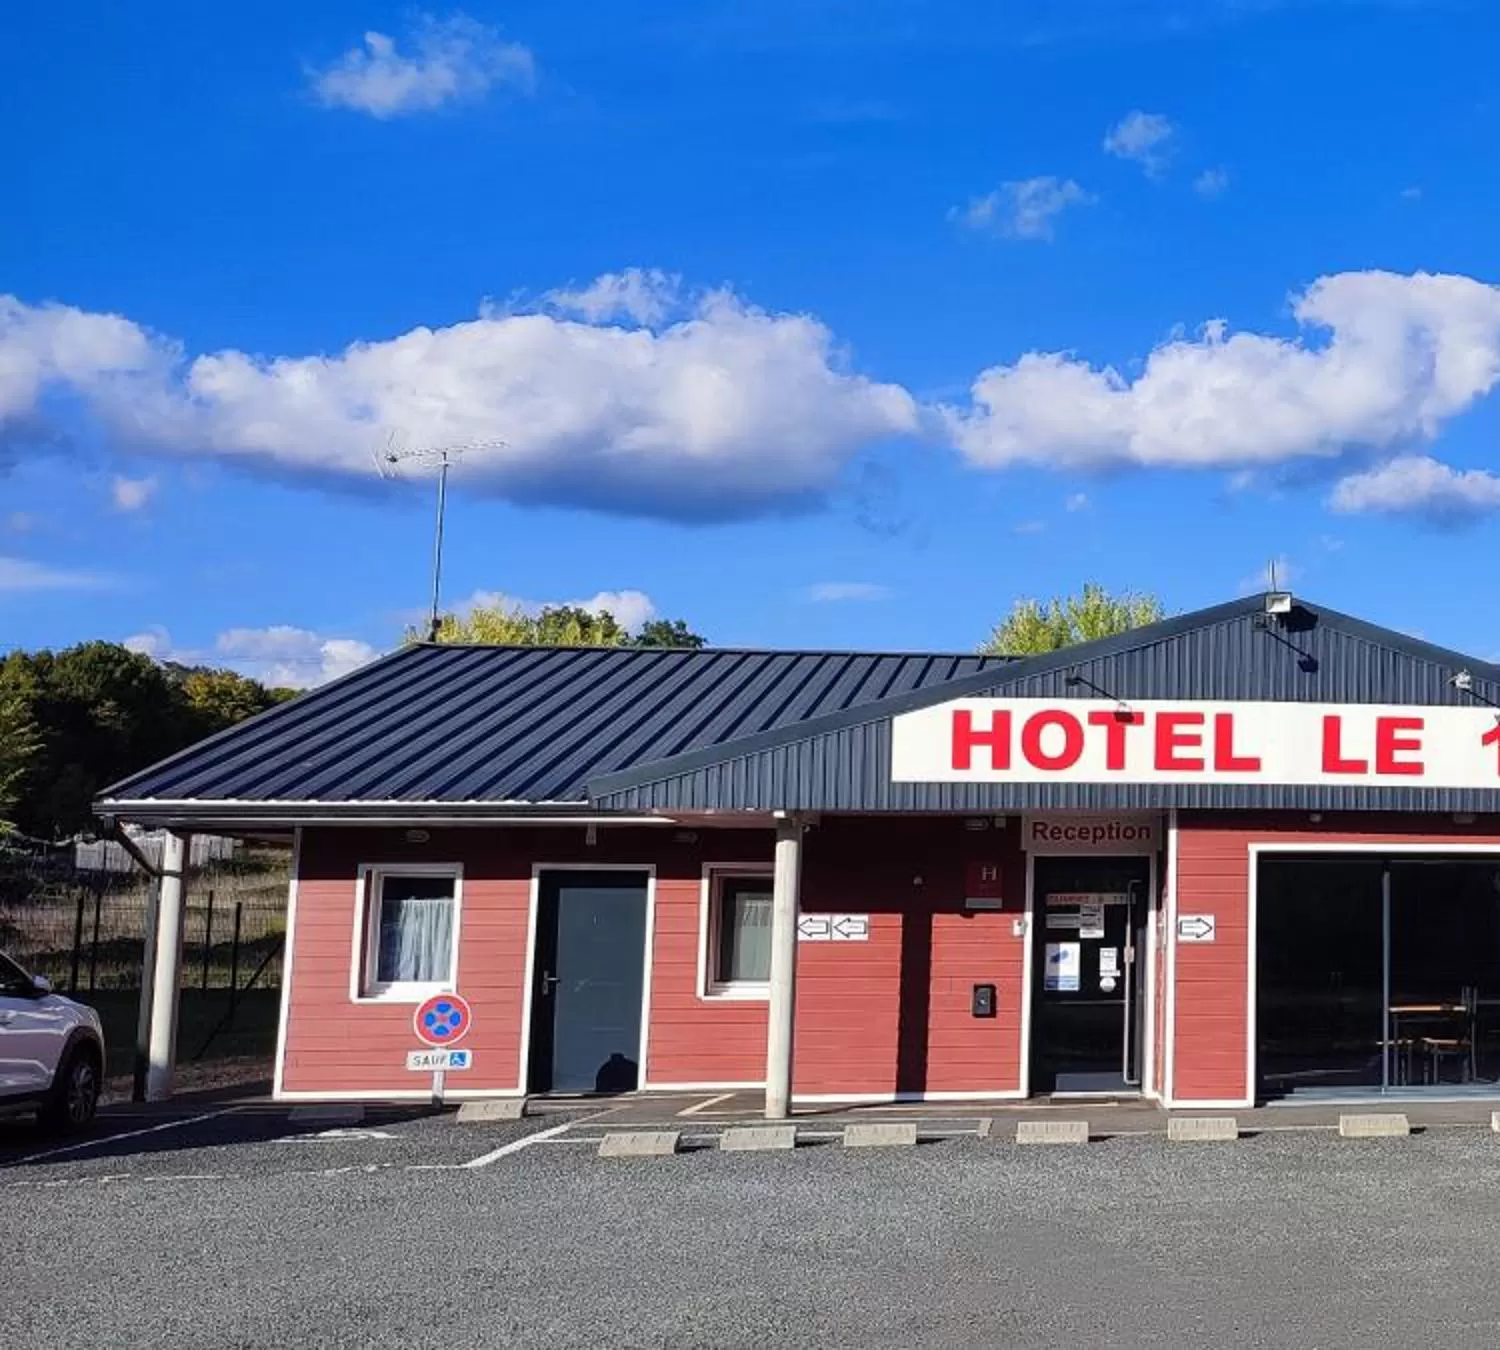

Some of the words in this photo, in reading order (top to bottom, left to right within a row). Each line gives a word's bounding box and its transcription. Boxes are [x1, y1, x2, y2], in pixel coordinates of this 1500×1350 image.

[950, 709, 1261, 774] HOTEL
[1321, 714, 1425, 775] LE
[1032, 821, 1151, 844] Reception
[981, 866, 997, 881] H
[412, 1055, 447, 1067] SAUF
